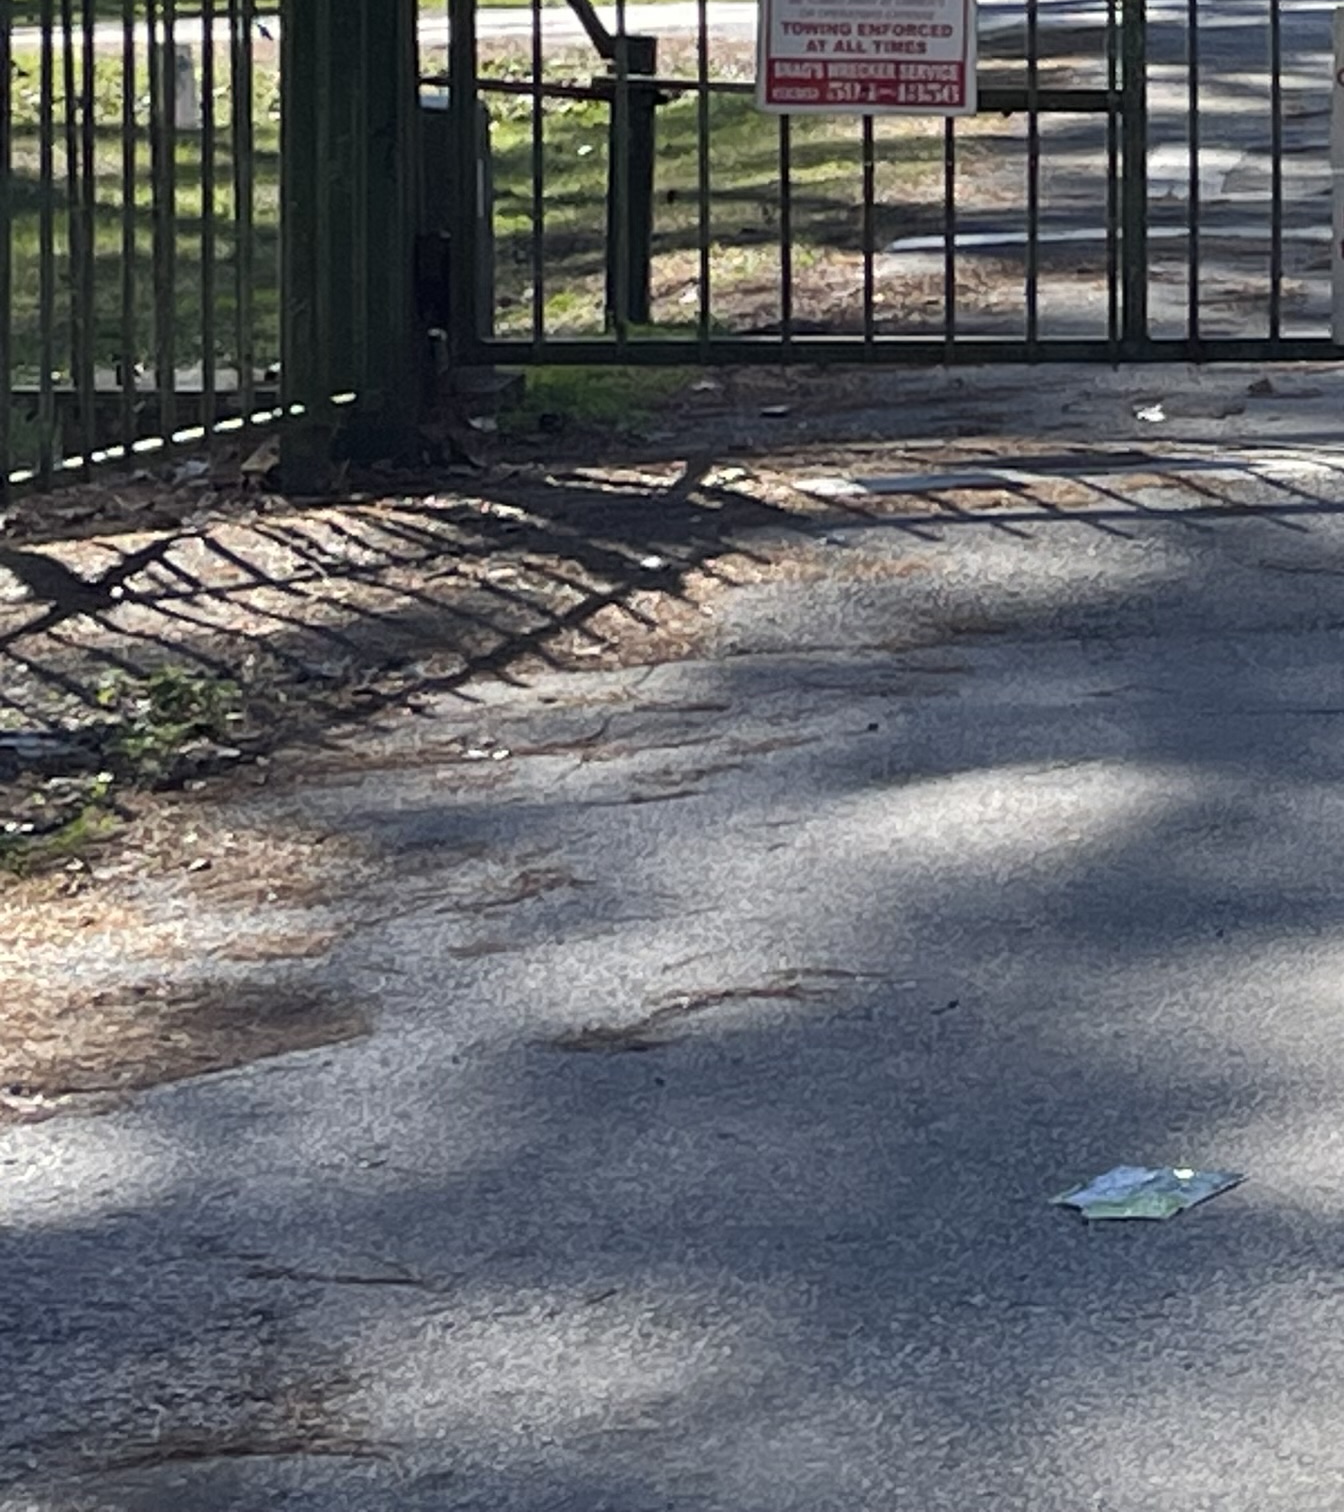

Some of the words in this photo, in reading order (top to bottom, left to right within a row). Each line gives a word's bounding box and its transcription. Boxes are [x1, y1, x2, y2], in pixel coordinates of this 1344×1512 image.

[781, 22, 852, 36] TOWING
[857, 23, 954, 38] ENFORCED
[806, 40, 827, 53] AT
[833, 40, 866, 54] ALL
[872, 41, 927, 54] TIMES
[898, 64, 959, 81] SERVICE
